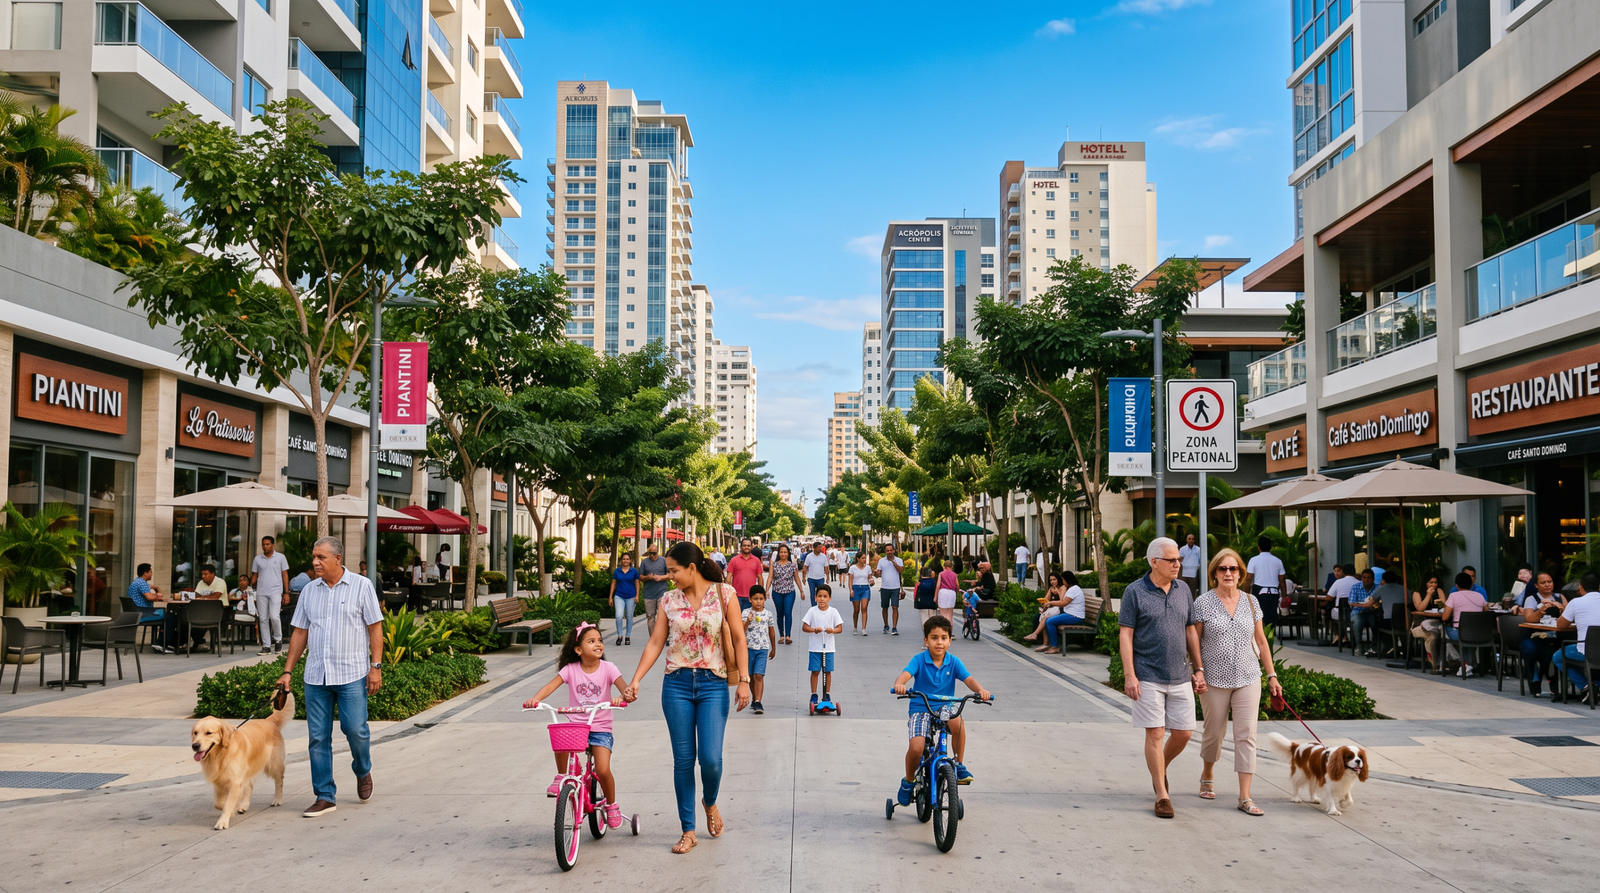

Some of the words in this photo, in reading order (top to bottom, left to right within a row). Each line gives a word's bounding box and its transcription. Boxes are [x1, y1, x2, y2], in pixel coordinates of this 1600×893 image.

[1080, 144, 1127, 153] HOTELL
[898, 229, 941, 237] ACRÓPOLIS
[35, 373, 122, 417] PIANTINI
[397, 348, 412, 417] PIANTINI
[1471, 362, 1600, 419] RESTAURANTE
[186, 406, 205, 438] La
[206, 410, 255, 443] Patisserie
[1328, 422, 1349, 447] Café
[1350, 420, 1378, 442] Santo
[1380, 408, 1430, 435] Domingo
[1172, 452, 1233, 463] PEATONAL
[1186, 436, 1218, 448] ZONA
[1270, 429, 1299, 461] CAFÉ
[1522, 447, 1541, 458] SANTO
[1541, 443, 1567, 456] DOMINGO
